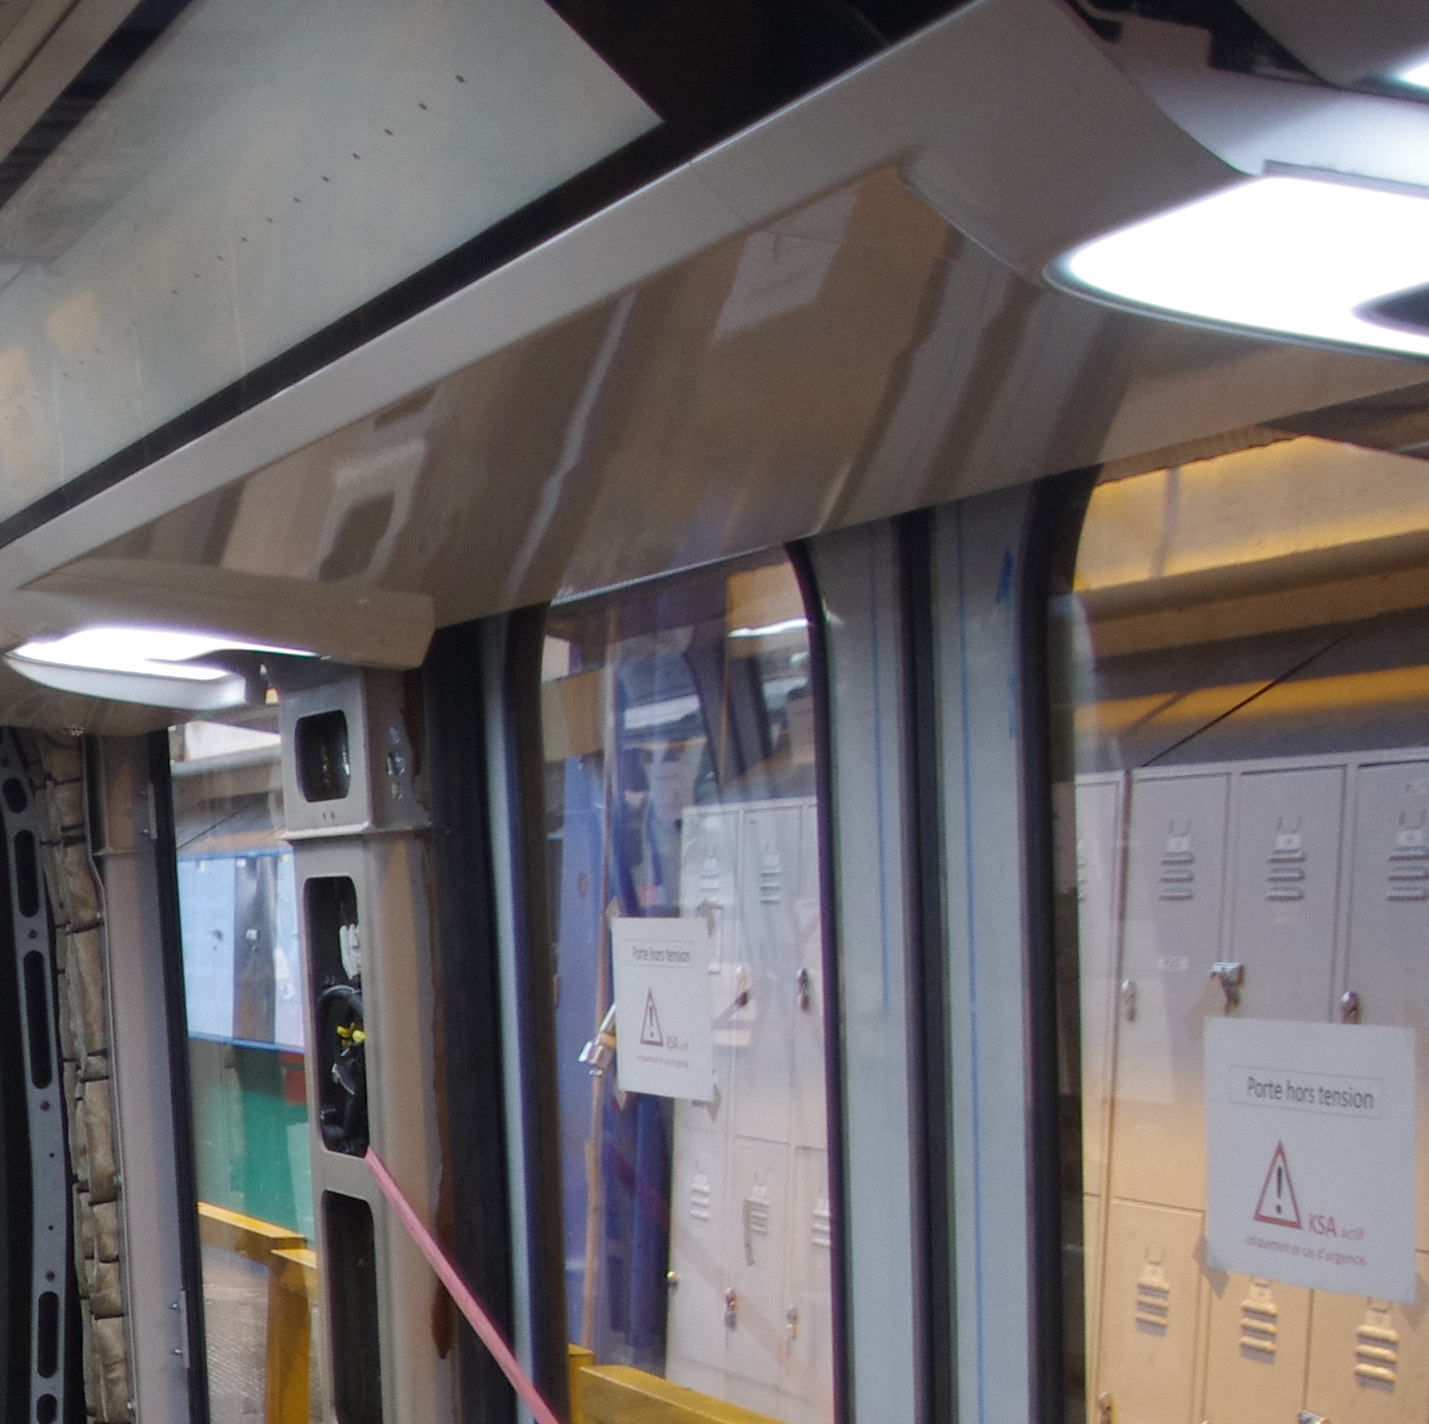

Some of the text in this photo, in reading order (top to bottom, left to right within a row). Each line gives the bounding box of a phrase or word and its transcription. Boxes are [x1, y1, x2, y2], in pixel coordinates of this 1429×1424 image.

[1246, 1075, 1374, 1110] Porte hors tension
[1308, 1213, 1337, 1237] KSA
